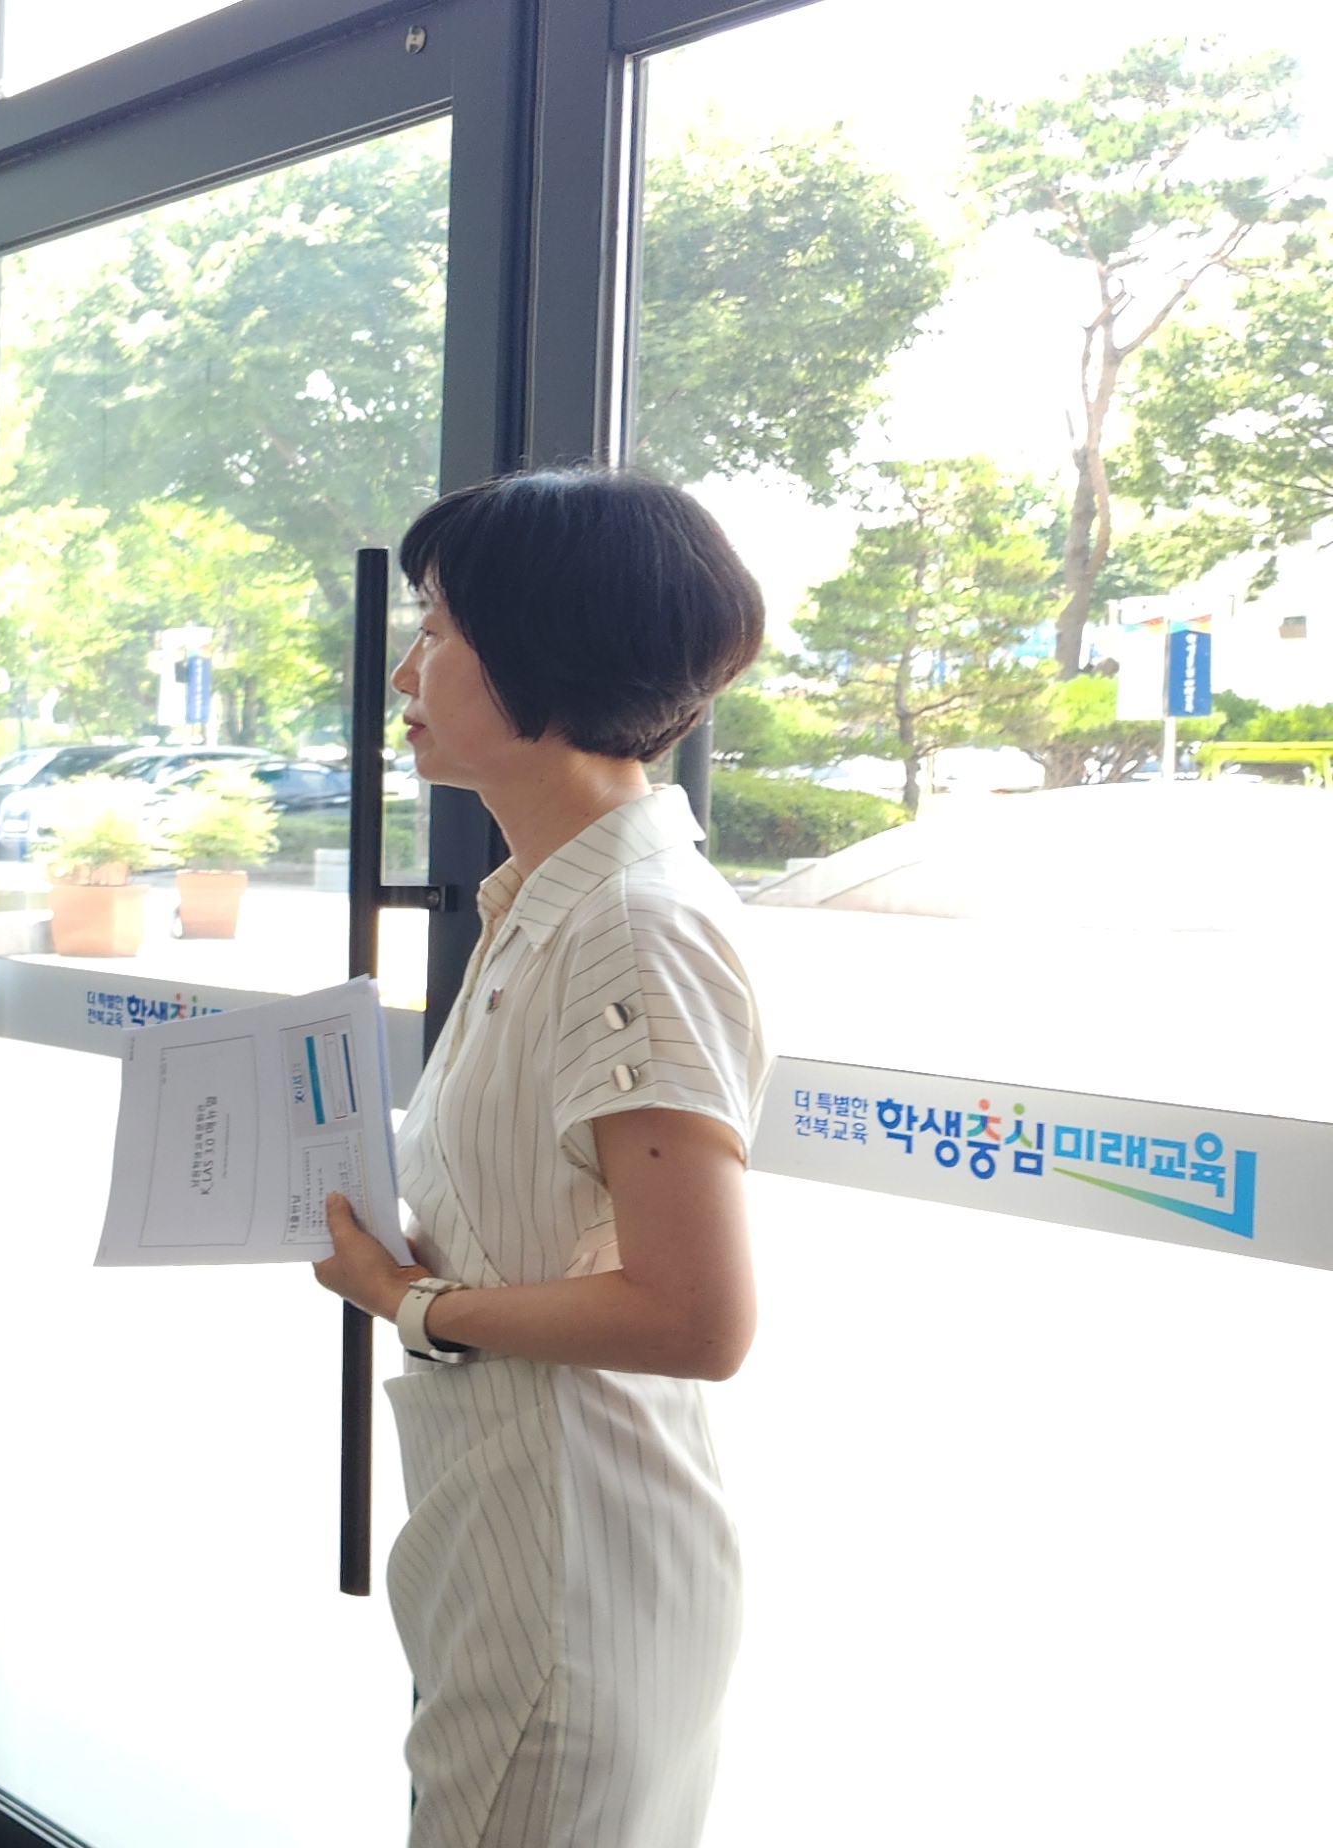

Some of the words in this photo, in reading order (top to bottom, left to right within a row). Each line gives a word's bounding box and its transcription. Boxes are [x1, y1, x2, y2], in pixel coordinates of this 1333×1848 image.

[87, 991, 96, 1005] 더
[87, 1008, 124, 1028] 전북교육
[794, 1090, 810, 1112] 더
[816, 1092, 868, 1120] 특별한
[794, 1113, 868, 1145] 전북교육
[876, 1098, 1044, 1180] 학생중심
[1053, 1125, 1226, 1198] 미래교육
